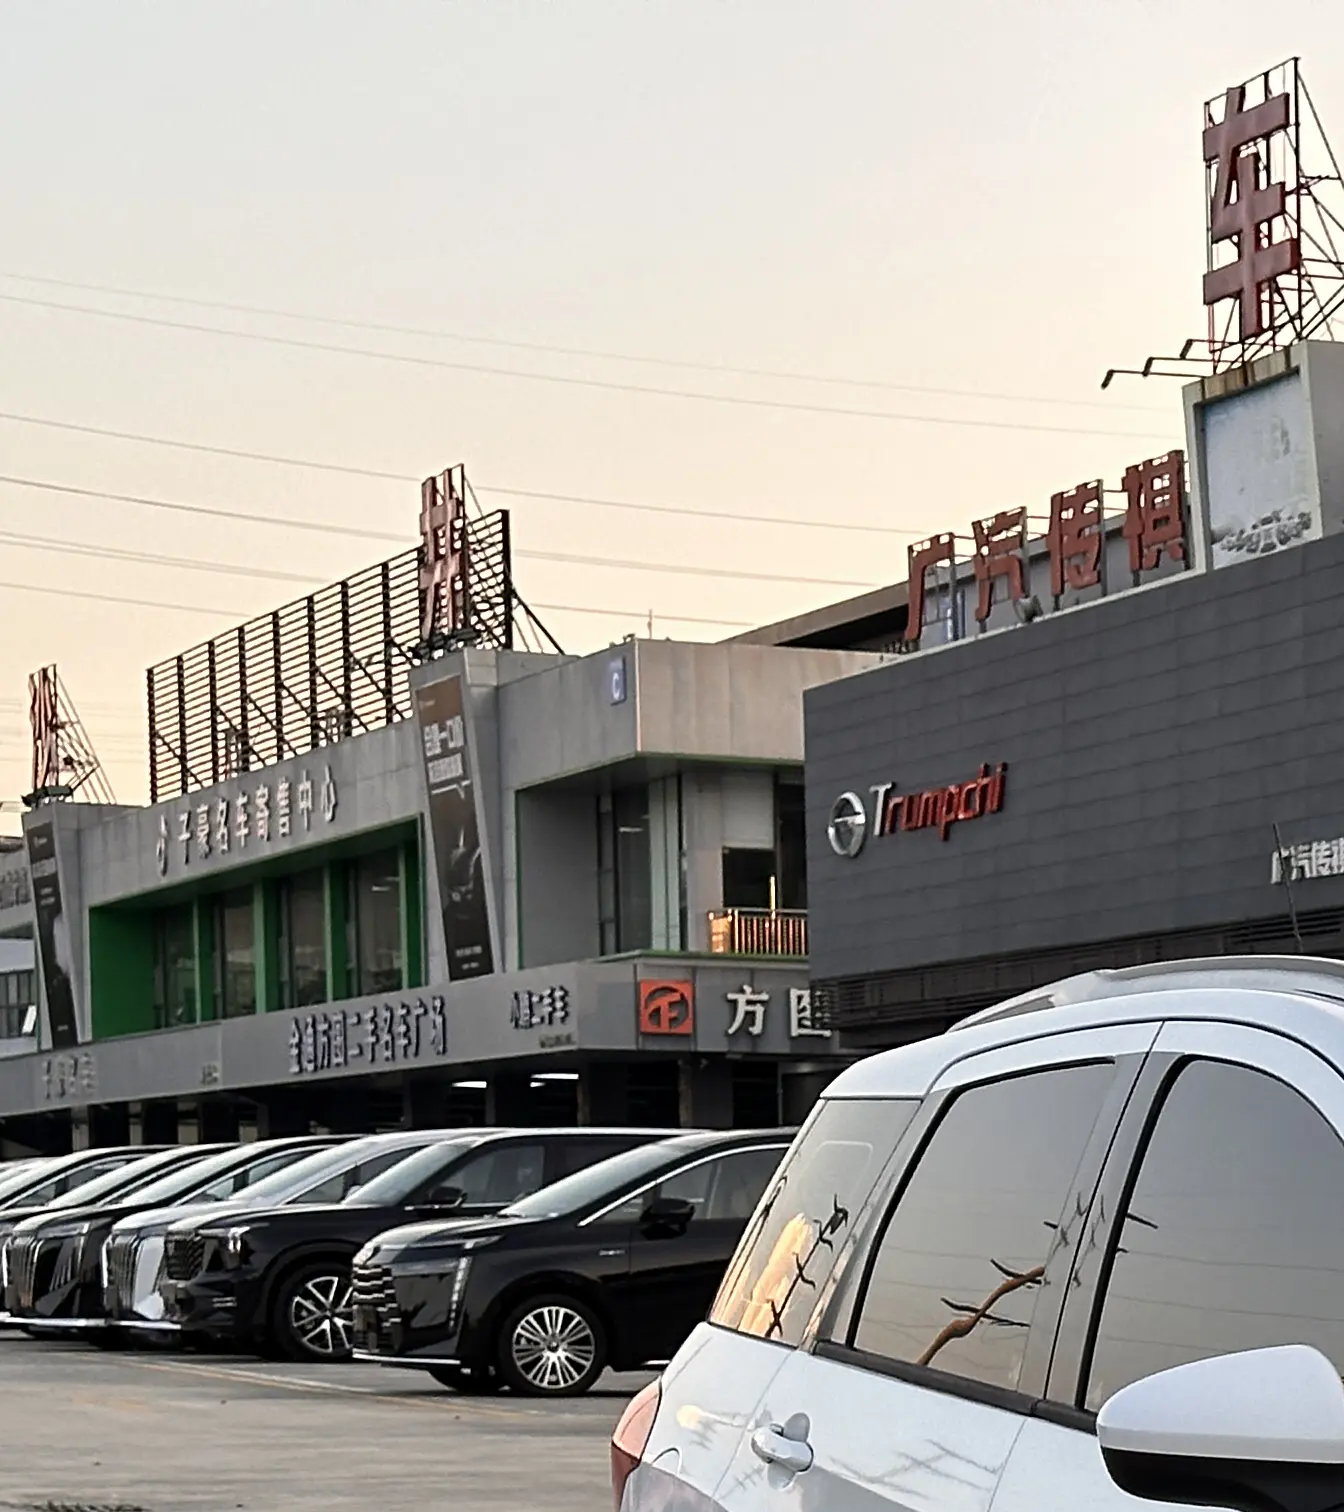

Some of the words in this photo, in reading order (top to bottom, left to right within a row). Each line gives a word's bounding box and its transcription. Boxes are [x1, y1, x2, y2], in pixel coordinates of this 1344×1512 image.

[905, 450, 1187, 641] 广汽传祺
[868, 762, 1008, 841] Trumpchi
